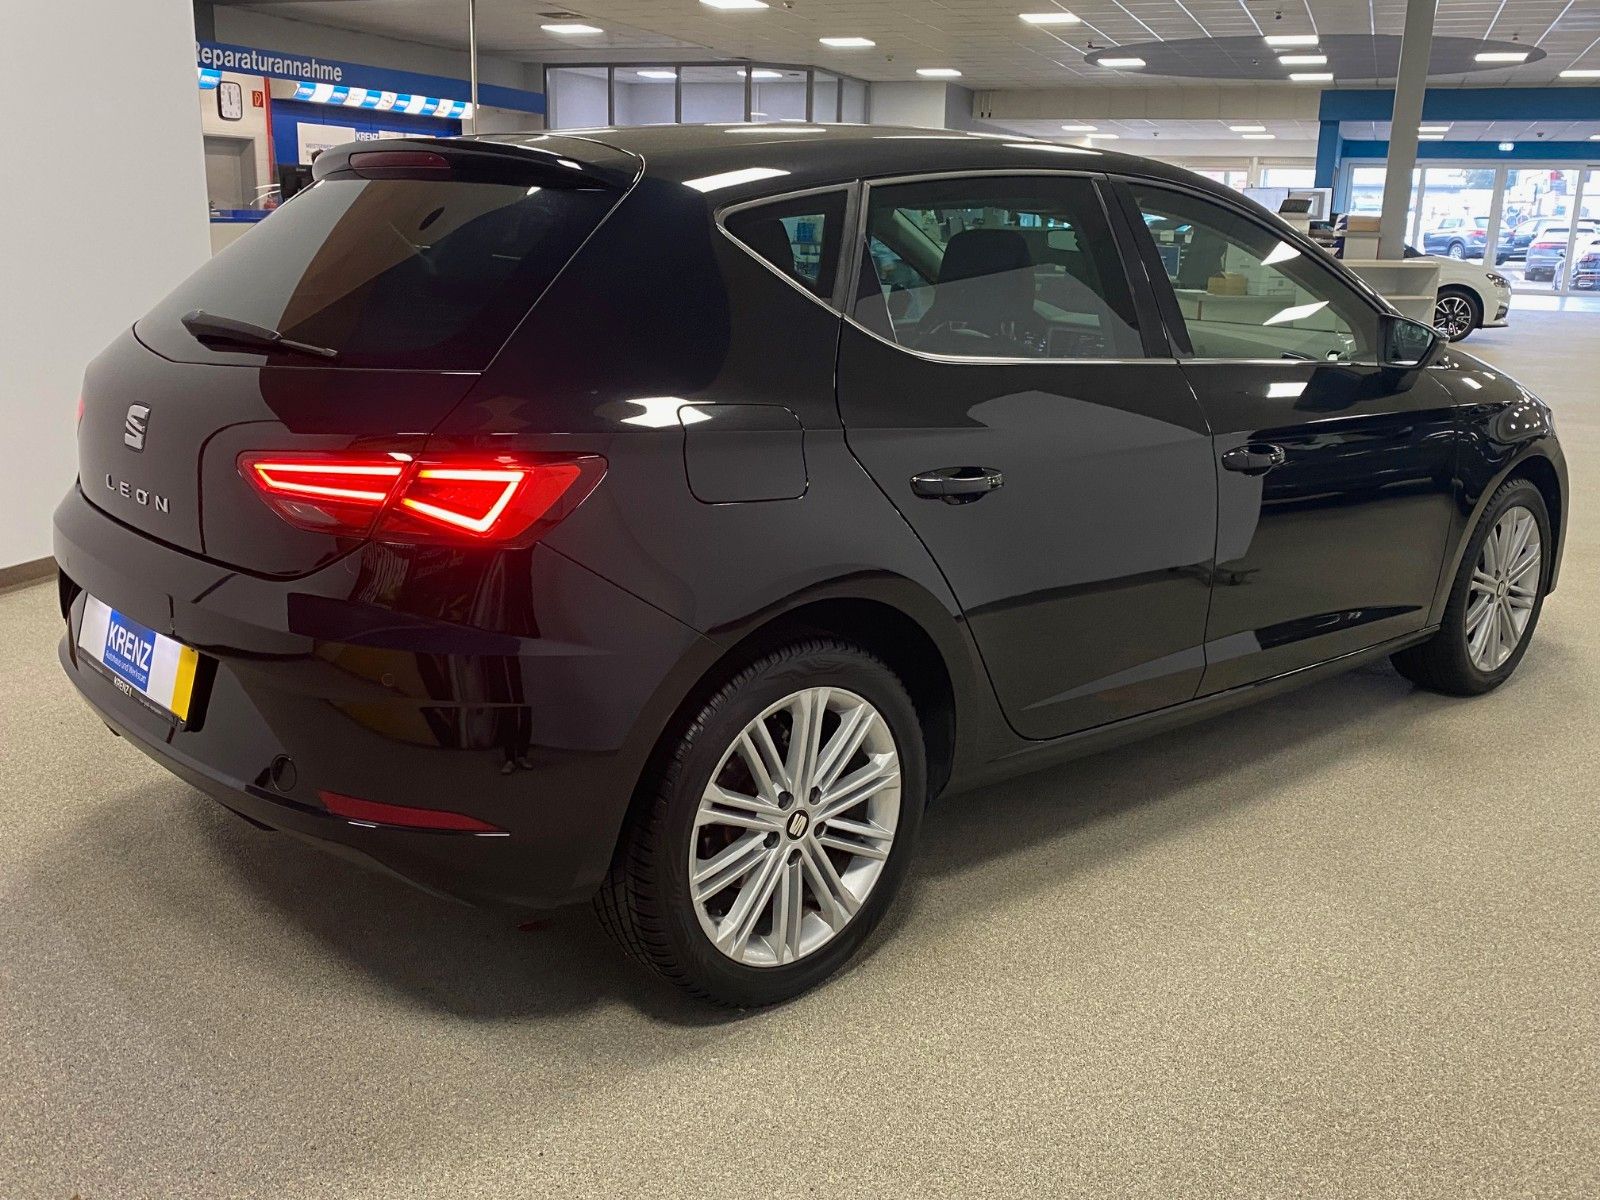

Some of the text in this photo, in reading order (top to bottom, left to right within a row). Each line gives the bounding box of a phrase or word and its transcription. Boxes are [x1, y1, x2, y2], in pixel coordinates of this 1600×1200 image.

[105, 473, 170, 513] LEON
[108, 621, 152, 672] KRENZ
[114, 676, 130, 695] KRENZ
